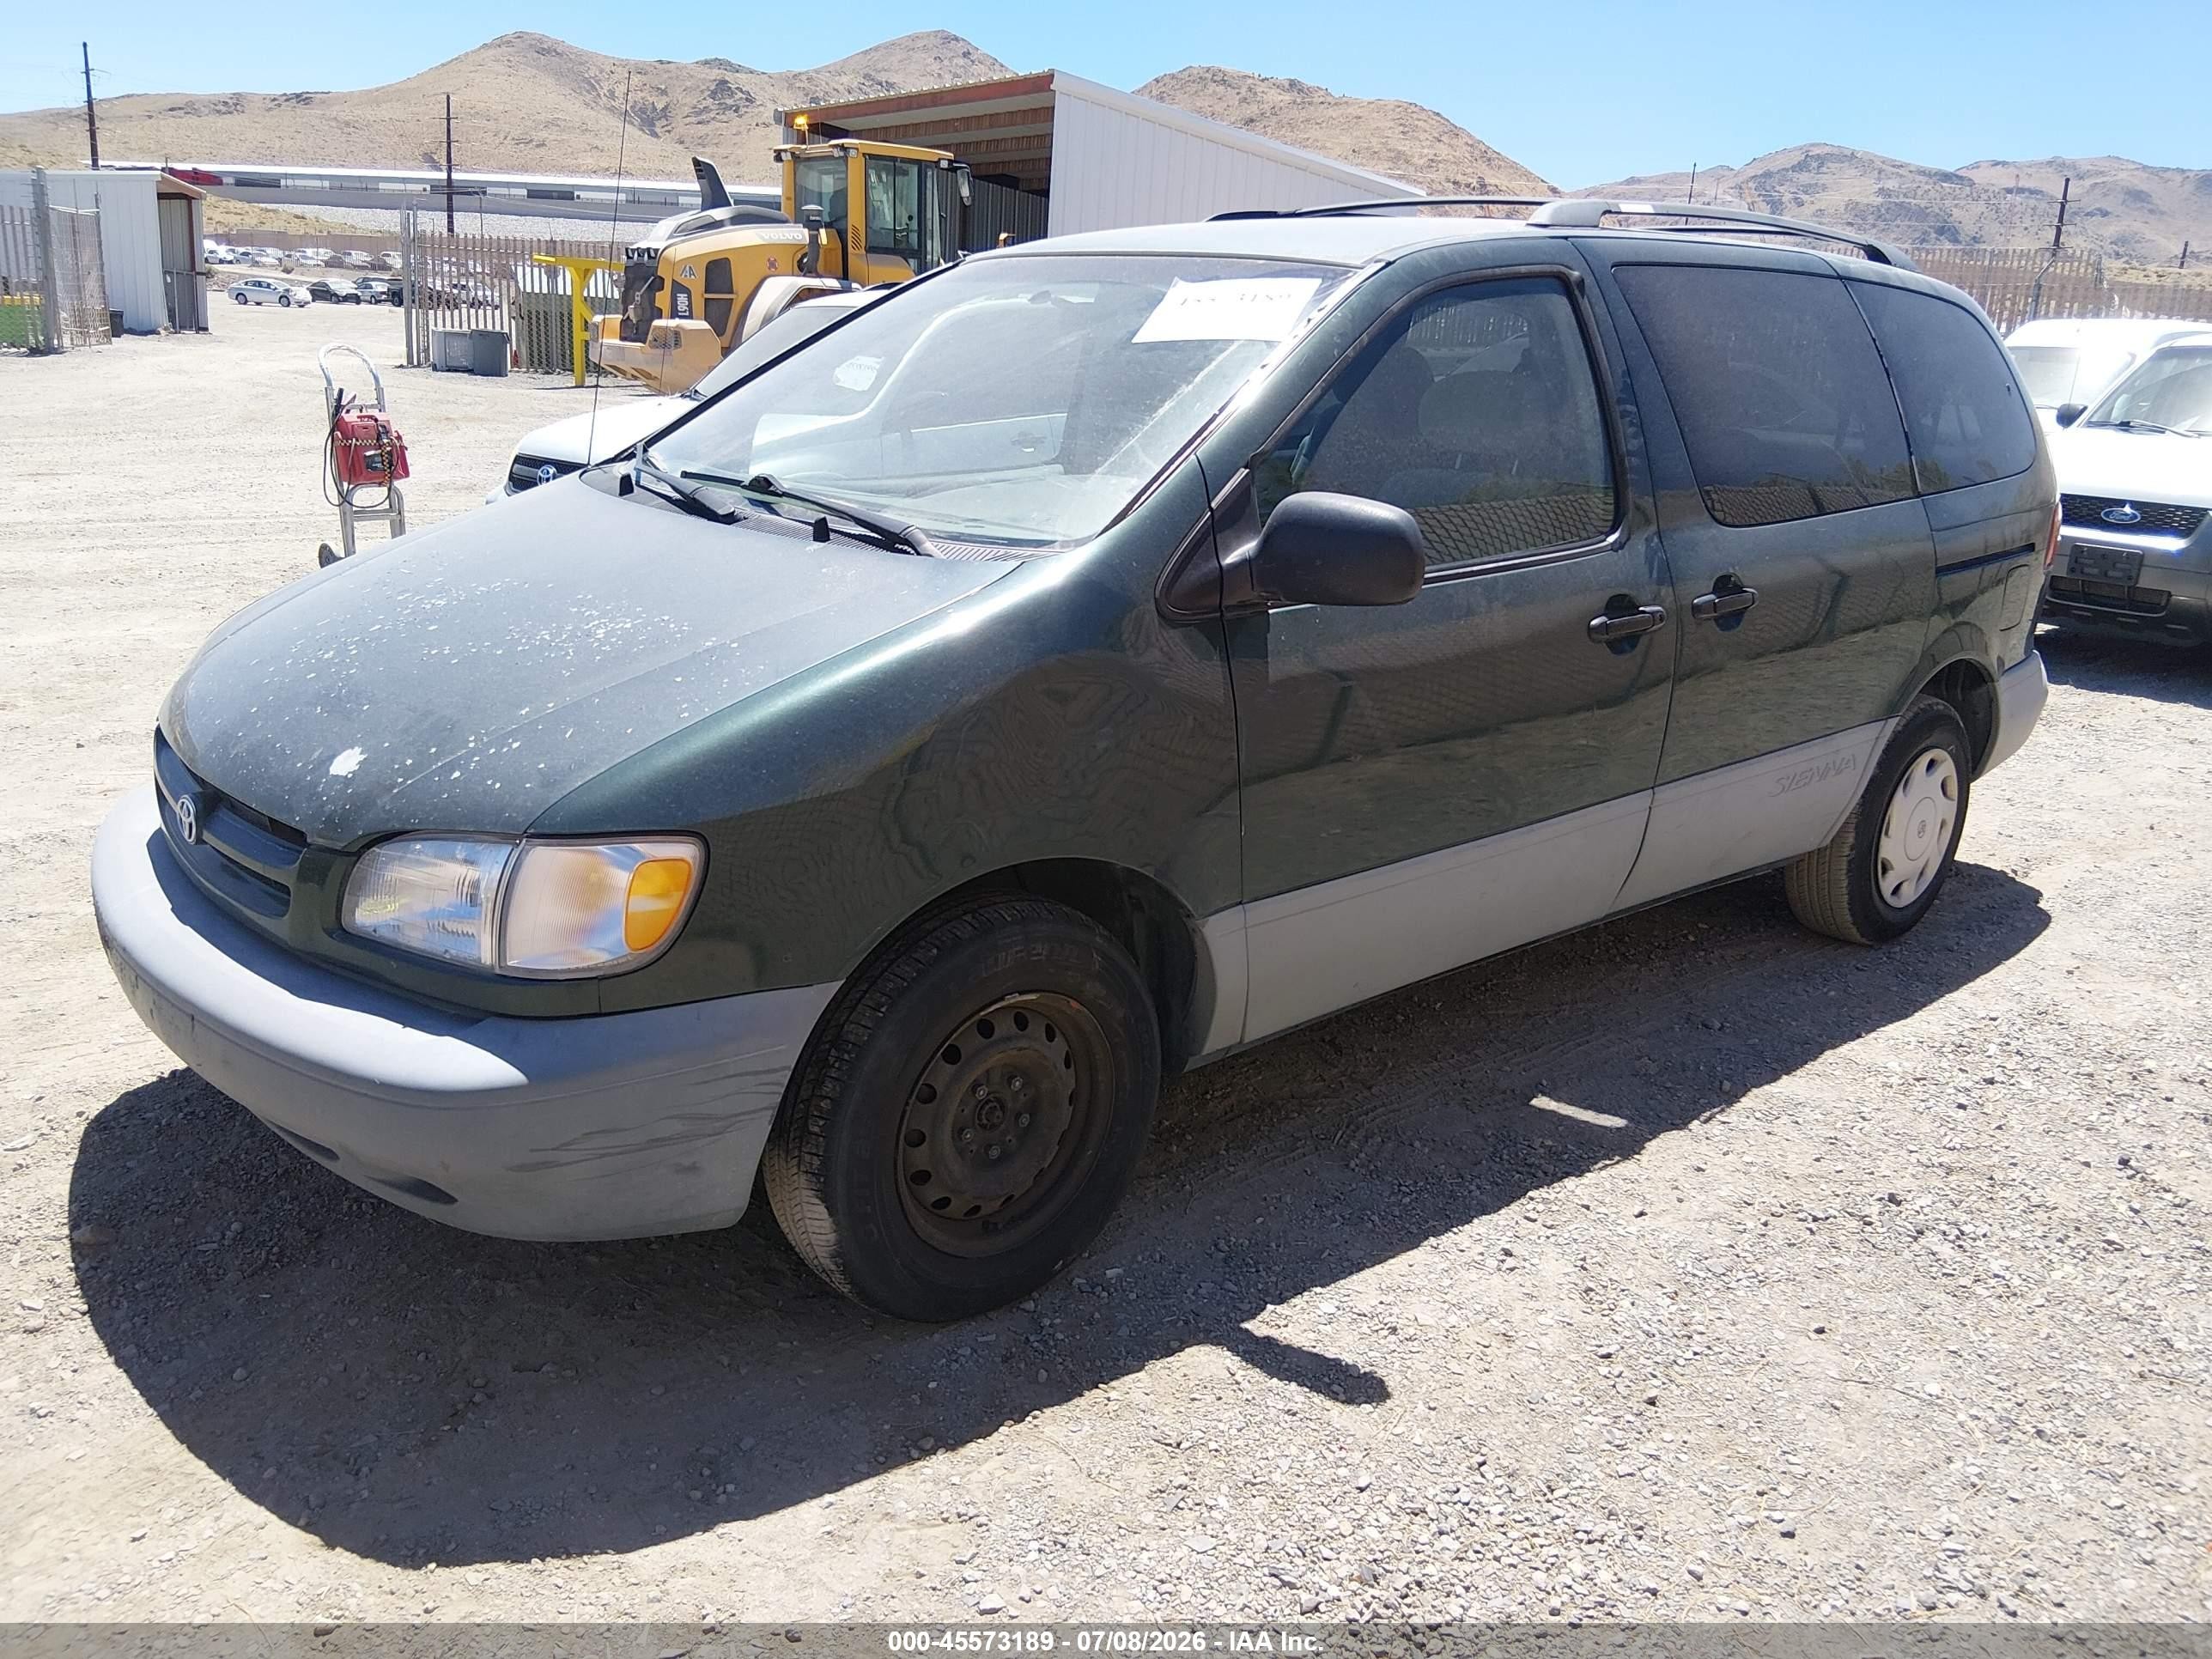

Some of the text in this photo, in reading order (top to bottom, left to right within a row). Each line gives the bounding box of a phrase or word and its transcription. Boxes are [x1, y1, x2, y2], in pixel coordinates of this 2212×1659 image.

[762, 232, 803, 240] VOLVO
[677, 293, 690, 316] L90H
[1767, 753, 1856, 798] SIENNA
